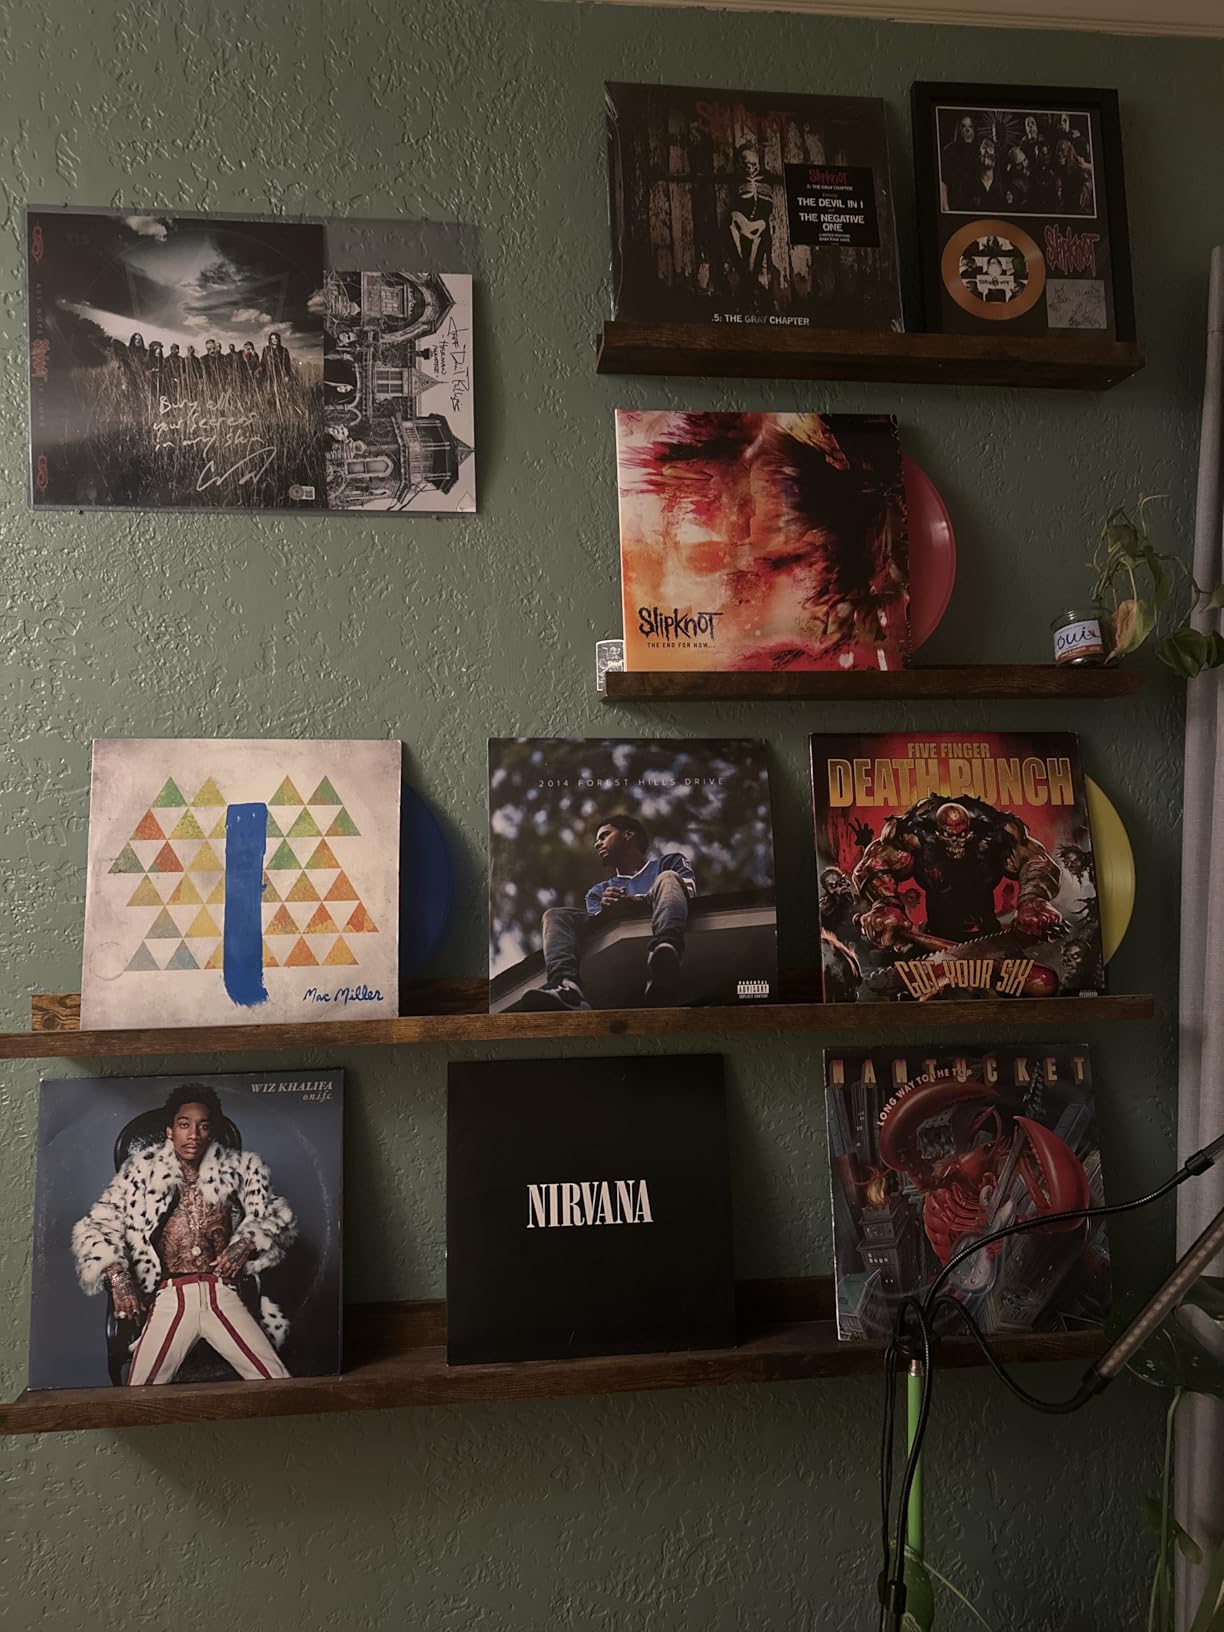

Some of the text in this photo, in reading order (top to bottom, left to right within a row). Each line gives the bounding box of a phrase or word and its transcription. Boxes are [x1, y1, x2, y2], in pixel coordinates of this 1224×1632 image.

[797, 197, 817, 206] THE
[818, 198, 846, 208] DEVIL
[847, 200, 858, 209] IN
[799, 212, 865, 224] THE NEGATIVE
[822, 223, 844, 232] ONE
[724, 314, 743, 323] THE
[744, 315, 768, 324] GRAY
[769, 315, 810, 326] CHAPTER
[907, 743, 991, 758] FIVE FINGER
[538, 777, 725, 788] 2014 FOREST HILLS DRIVE
[827, 757, 1075, 808] DEATH PUNCH
[894, 959, 1035, 1000] GOT YOUR SIX
[302, 984, 384, 1005] Mac Miller
[738, 985, 768, 993] ADVISORY
[250, 1080, 333, 1093] WIZ KHALIFA
[877, 1096, 898, 1127] LONG
[896, 1082, 917, 1100] WAY
[916, 1072, 930, 1086] TO
[932, 1067, 950, 1079] THE
[526, 1179, 655, 1229] NIRVANA
